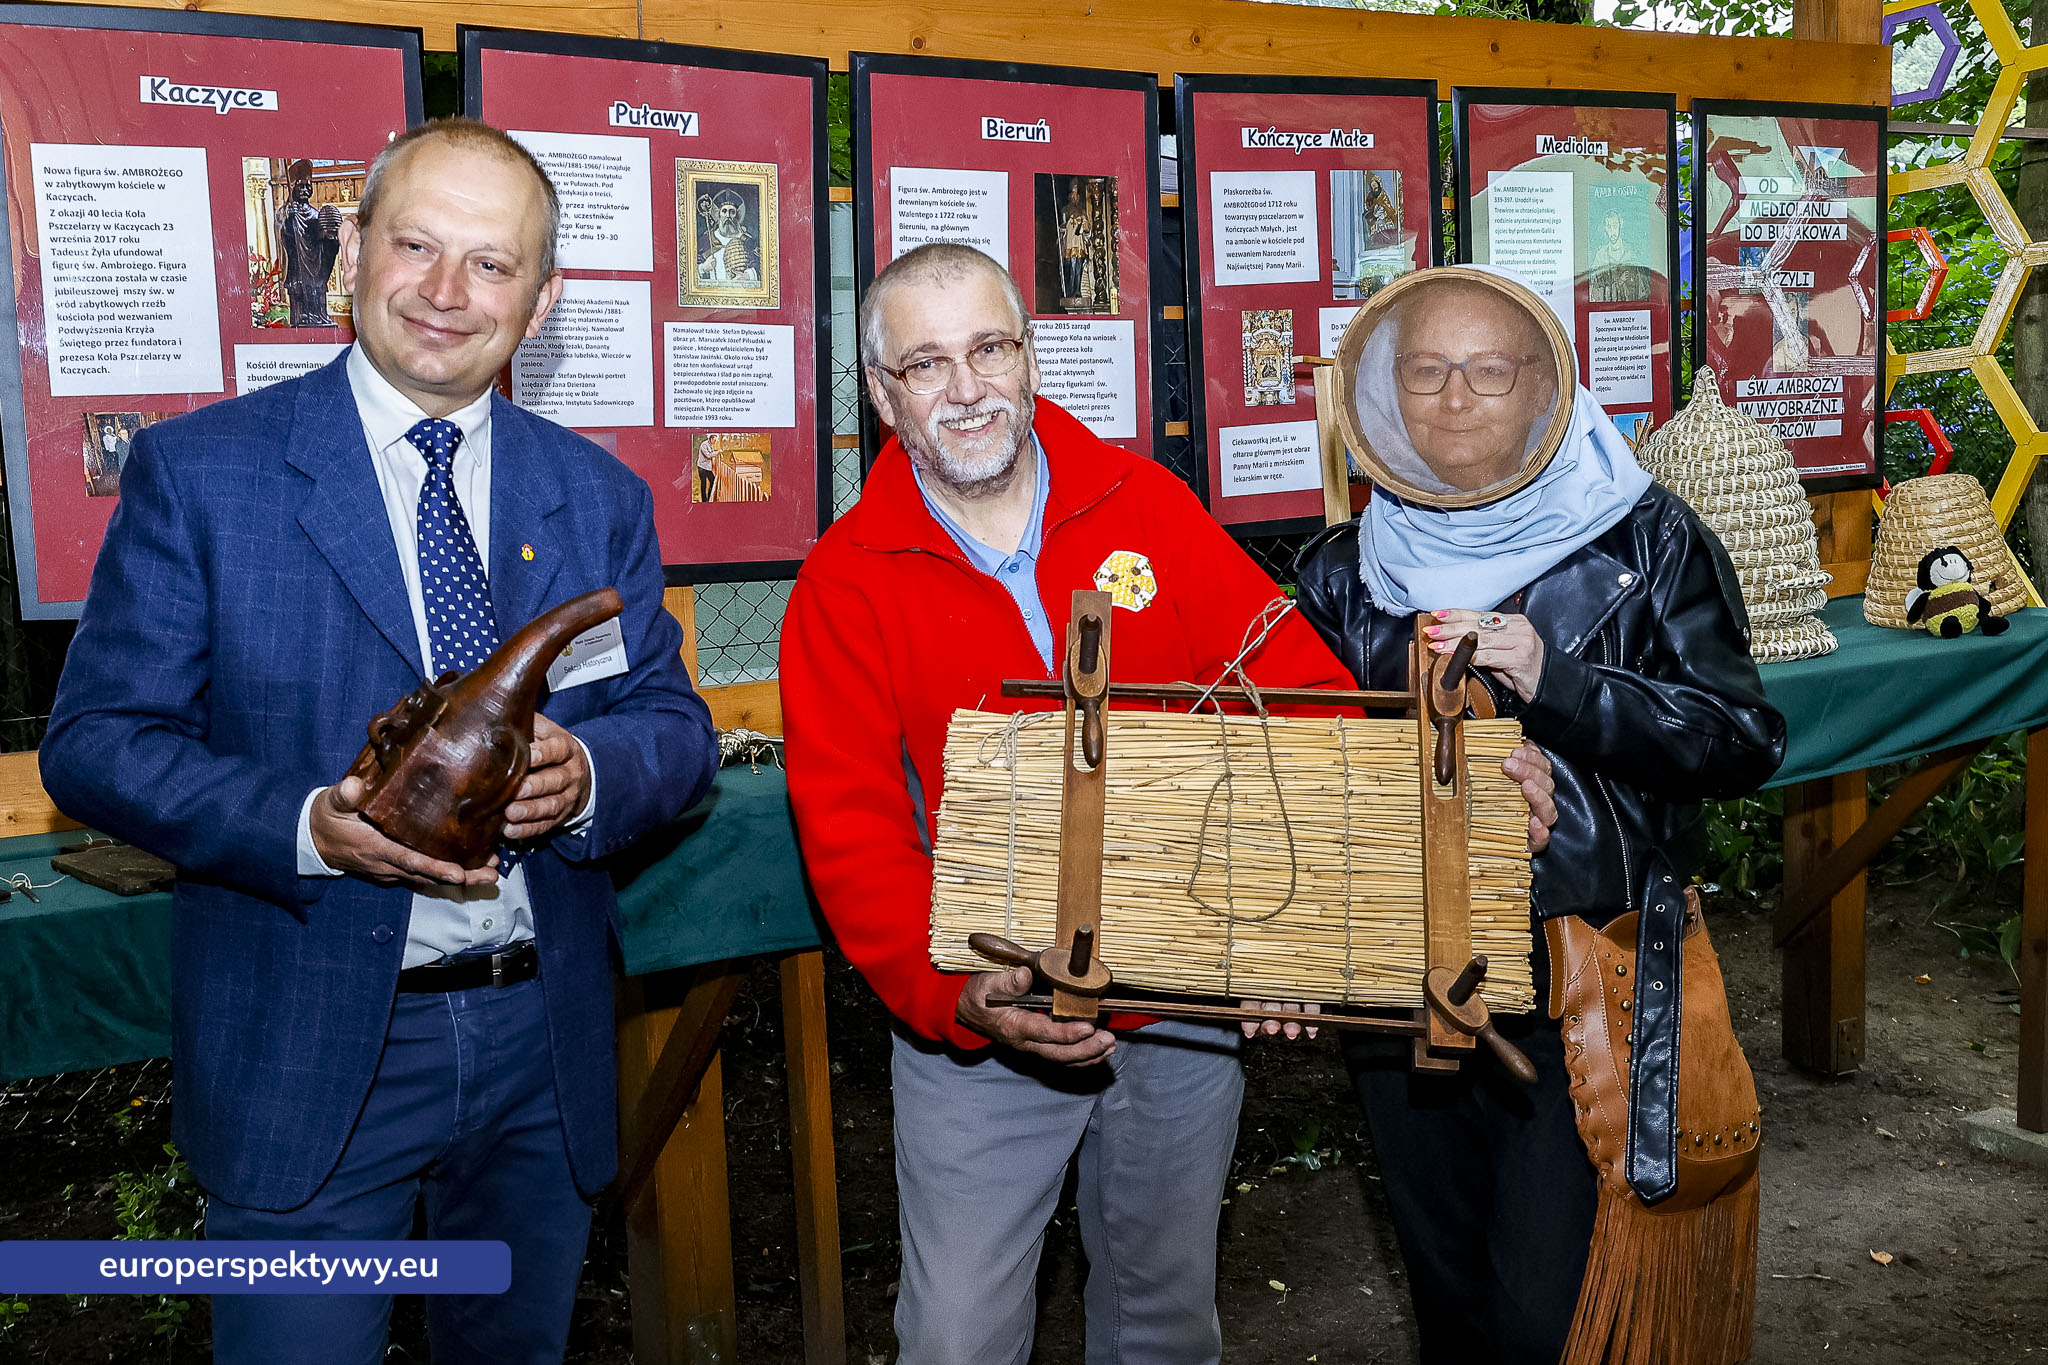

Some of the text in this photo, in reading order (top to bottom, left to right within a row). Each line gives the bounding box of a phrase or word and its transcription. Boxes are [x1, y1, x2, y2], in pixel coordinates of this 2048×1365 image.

[150, 77, 264, 112] Kaczyce
[615, 103, 692, 135] Puławy
[986, 118, 1046, 141] Bieruń
[1248, 126, 1369, 154] Kończyce Małe
[1542, 137, 1604, 154] Mediolan
[548, 152, 588, 160] AMBROŻEGO
[43, 166, 183, 178] Nowa figura św. AMBROŻEGO
[56, 180, 116, 190] zabytkowym
[118, 181, 155, 190] kościele
[1759, 178, 1779, 194] OD
[898, 186, 918, 194] Figura
[919, 186, 930, 194] św.
[931, 187, 968, 196] Ambrożego
[969, 188, 980, 196] jest
[46, 193, 97, 203] Kaczycach.
[898, 198, 977, 208] drewnianym kościele św.
[587, 202, 630, 211] instruktorów
[50, 209, 56, 217] Z
[58, 209, 85, 219] okazji
[87, 209, 100, 217] 40
[101, 209, 123, 218] lecia
[899, 211, 933, 219] Walentego
[48, 222, 101, 231] Pszczelarzy
[114, 223, 160, 232] Kaczycach
[162, 223, 174, 231] 23
[1745, 225, 1763, 240] DO
[50, 235, 140, 244] września 2017 roku
[51, 248, 89, 256] Tadeusz
[113, 248, 163, 257] ufundował
[82, 261, 98, 270] św.
[101, 261, 156, 271] Ambrożego.
[158, 261, 187, 271] Figura
[160, 274, 188, 282] czasie
[1772, 272, 1809, 287] CZYLI
[54, 287, 119, 296] jubileuszowej
[123, 288, 146, 296] mszy
[148, 286, 164, 295] św.
[79, 300, 139, 309] zabytkowych
[97, 313, 116, 322] pod
[117, 313, 173, 321] wezwaniem
[58, 326, 155, 336] Podwyższenia Krzyża
[104, 340, 129, 348] przez
[131, 338, 177, 347] fundatora
[178, 338, 182, 346] i
[59, 354, 95, 363] prezesa
[120, 353, 171, 361] Pszczelarzy
[60, 366, 110, 375] Kaczycach.
[246, 361, 277, 370] Kościół
[1776, 374, 1839, 394] AMBROŻY
[1741, 393, 1838, 417] W WYOBRAŹNI
